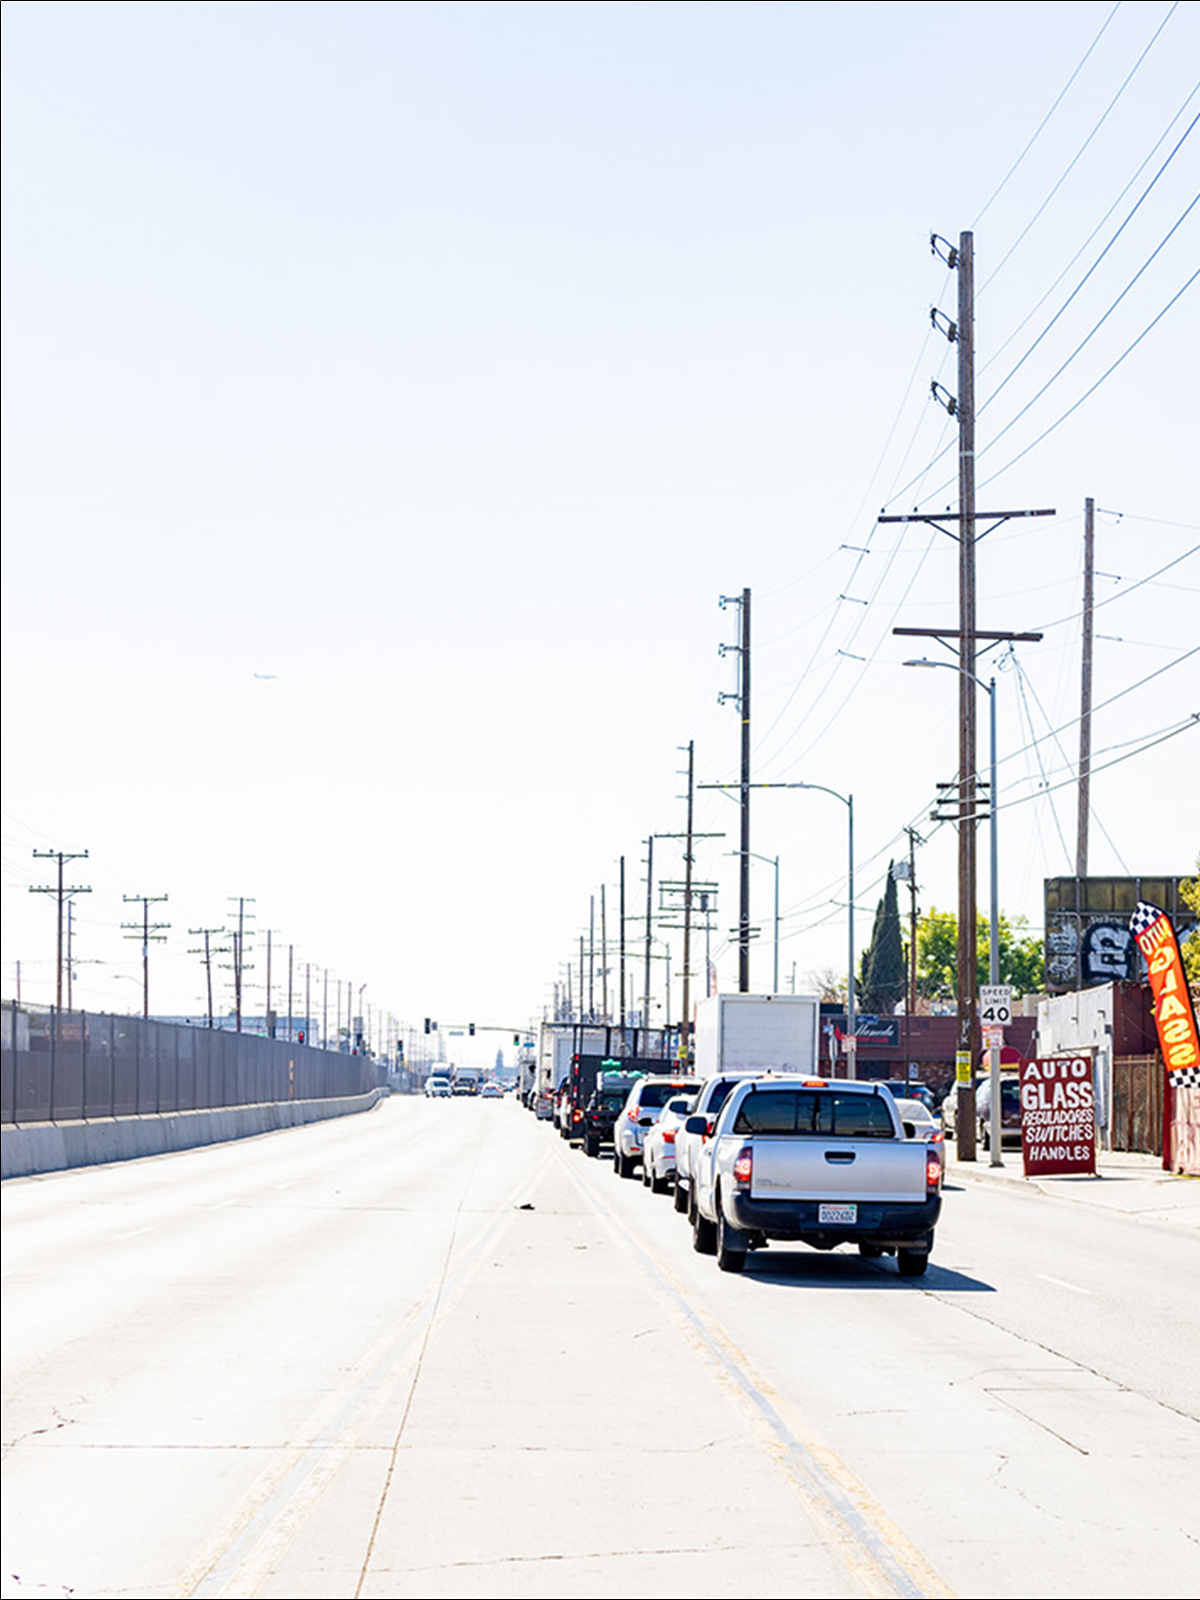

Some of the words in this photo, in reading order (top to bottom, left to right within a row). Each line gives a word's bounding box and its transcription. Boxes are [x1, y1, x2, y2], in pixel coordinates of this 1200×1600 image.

[982, 988, 1010, 996] SPEED
[982, 1006, 1009, 1022] 40
[1023, 1059, 1086, 1080] AUTO
[1022, 1081, 1092, 1110] GLASS
[1026, 1124, 1093, 1143] SWITCHES
[1029, 1146, 1090, 1160] HANDLES
